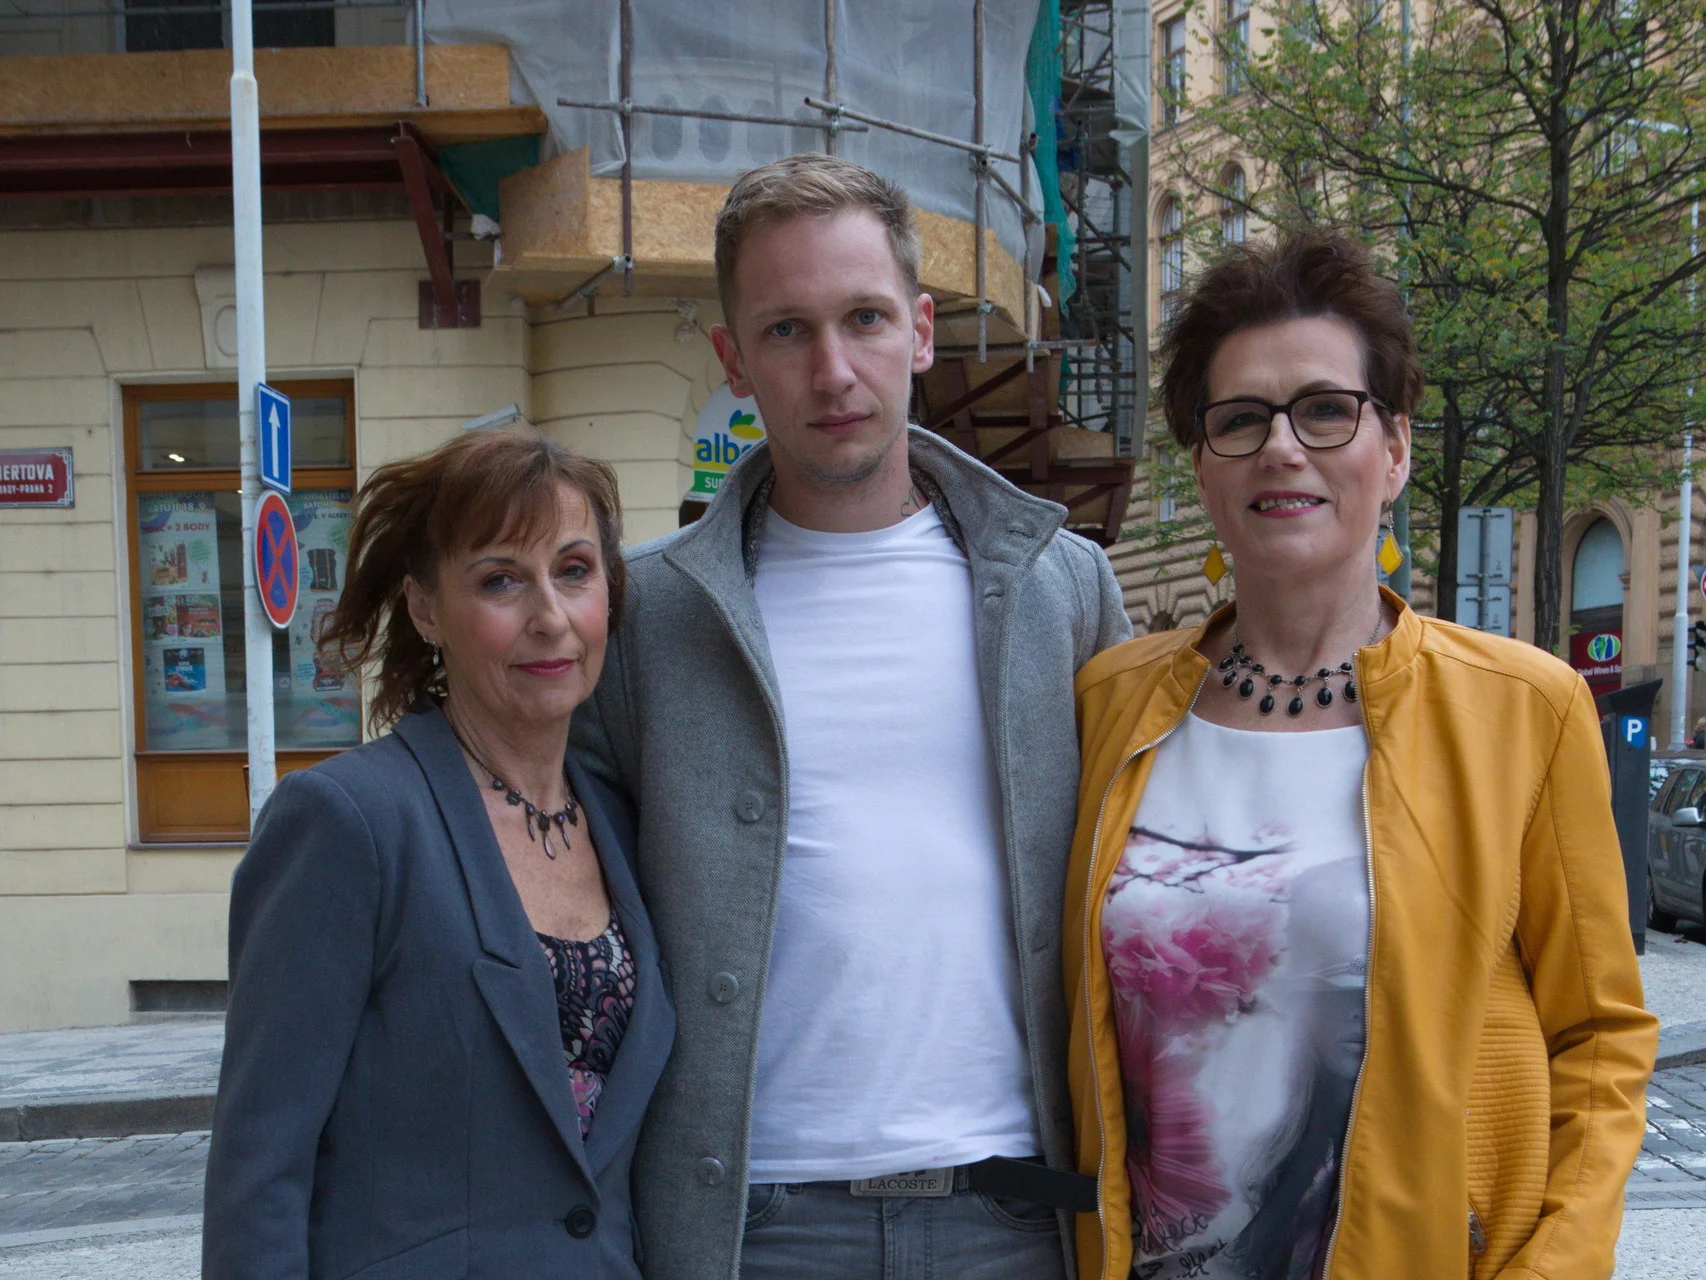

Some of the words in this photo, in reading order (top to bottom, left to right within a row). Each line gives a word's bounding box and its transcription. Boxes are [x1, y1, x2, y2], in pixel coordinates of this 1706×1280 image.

[47, 484, 54, 494] 2
[183, 522, 210, 531] BODY
[1627, 719, 1643, 742] P
[867, 1178, 937, 1191] LACOSTE
